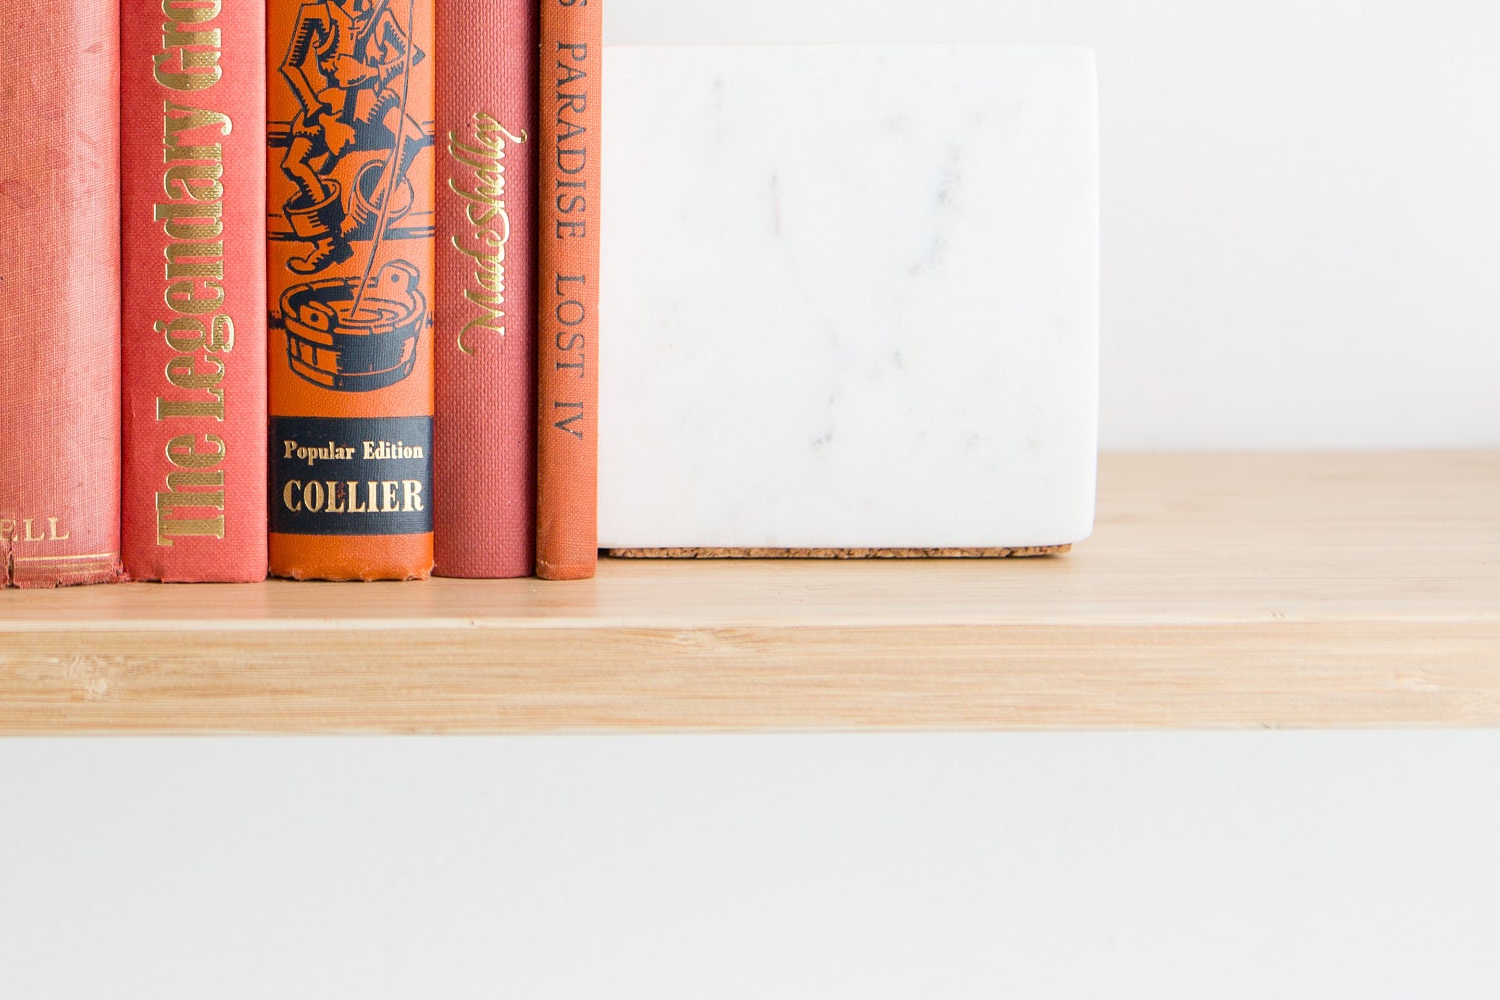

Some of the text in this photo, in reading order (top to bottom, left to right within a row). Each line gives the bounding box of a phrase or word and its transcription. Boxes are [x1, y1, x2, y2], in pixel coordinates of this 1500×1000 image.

[555, 40, 588, 241] PARADISE
[153, 99, 236, 422] Legendary
[554, 272, 586, 379] LOST
[283, 439, 424, 466] Popular Edition
[552, 400, 585, 441] IV
[155, 433, 227, 547] The
[282, 478, 425, 514] COLLIER
